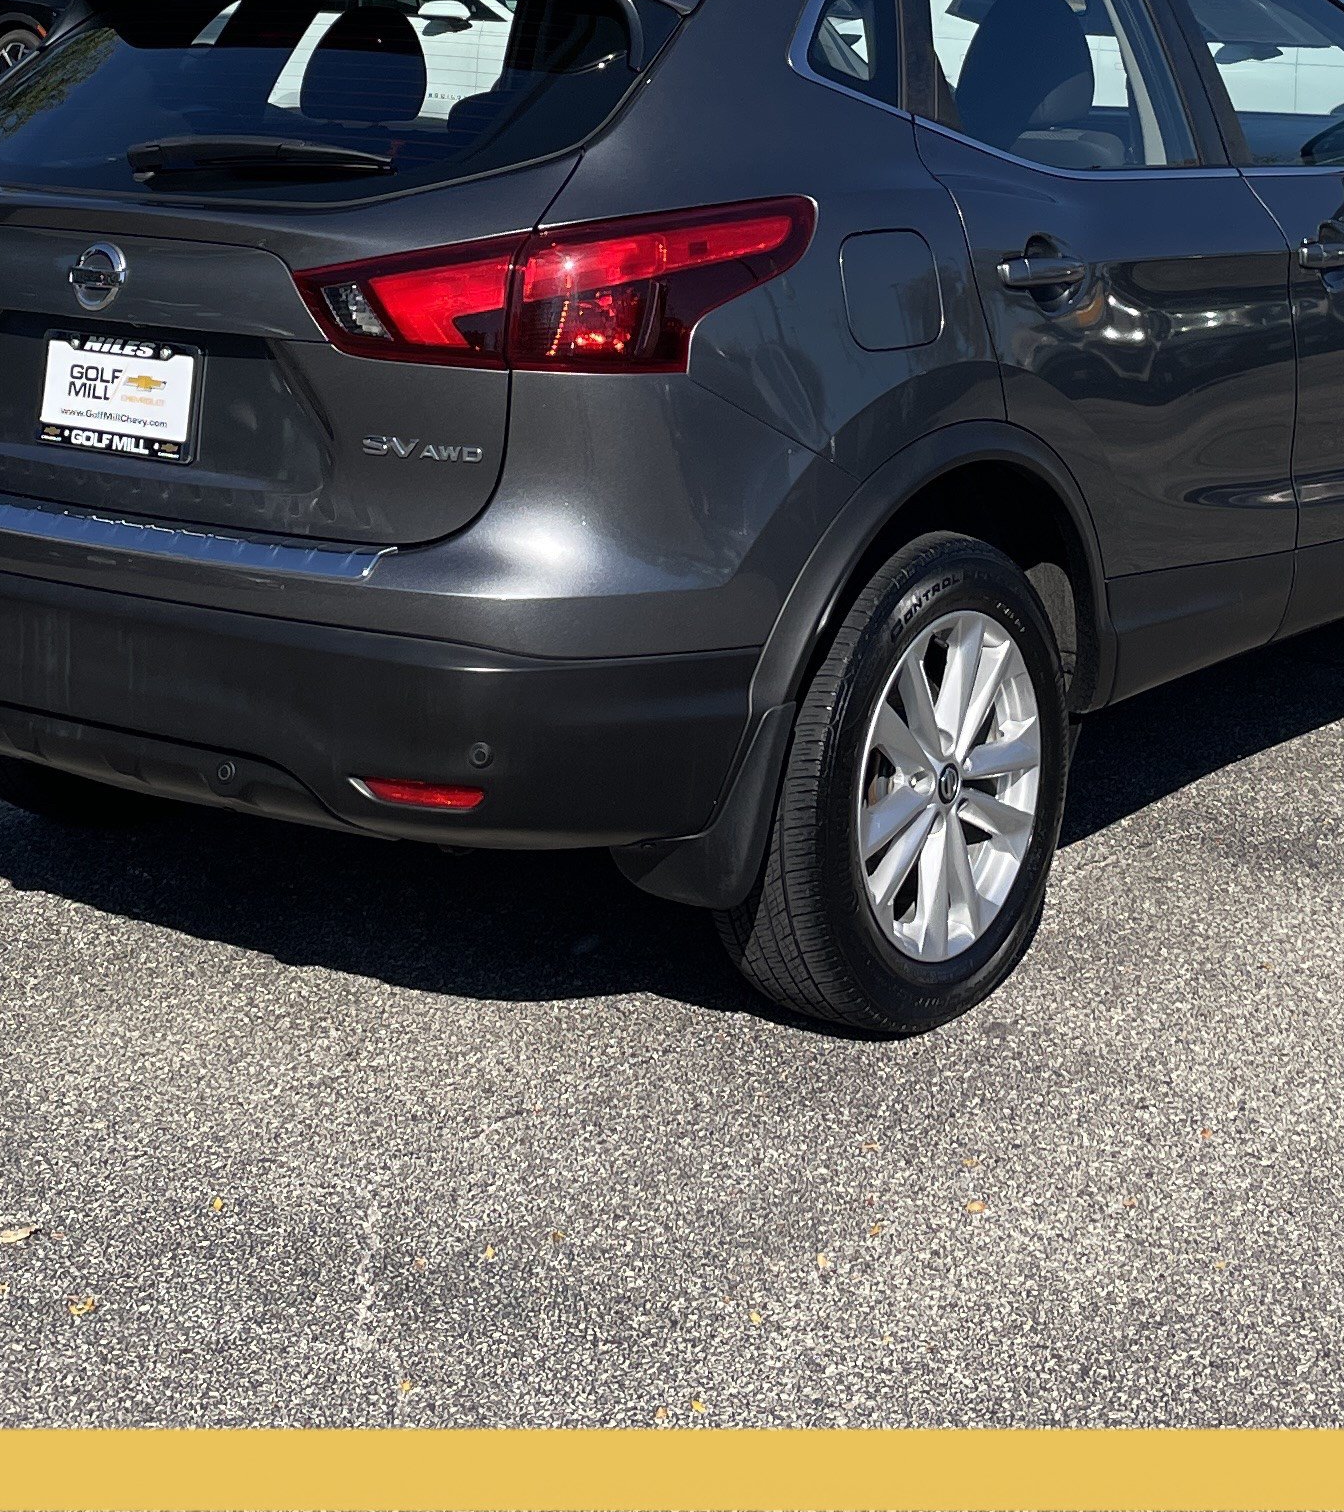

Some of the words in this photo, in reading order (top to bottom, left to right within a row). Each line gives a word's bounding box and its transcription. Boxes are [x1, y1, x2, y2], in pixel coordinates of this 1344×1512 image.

[83, 335, 157, 358] NILES
[70, 364, 123, 384] GOLF
[68, 381, 110, 400] MILL
[70, 429, 112, 448] GOLF
[112, 434, 149, 454] MILL
[362, 434, 419, 458] SV
[419, 444, 483, 463] AWD
